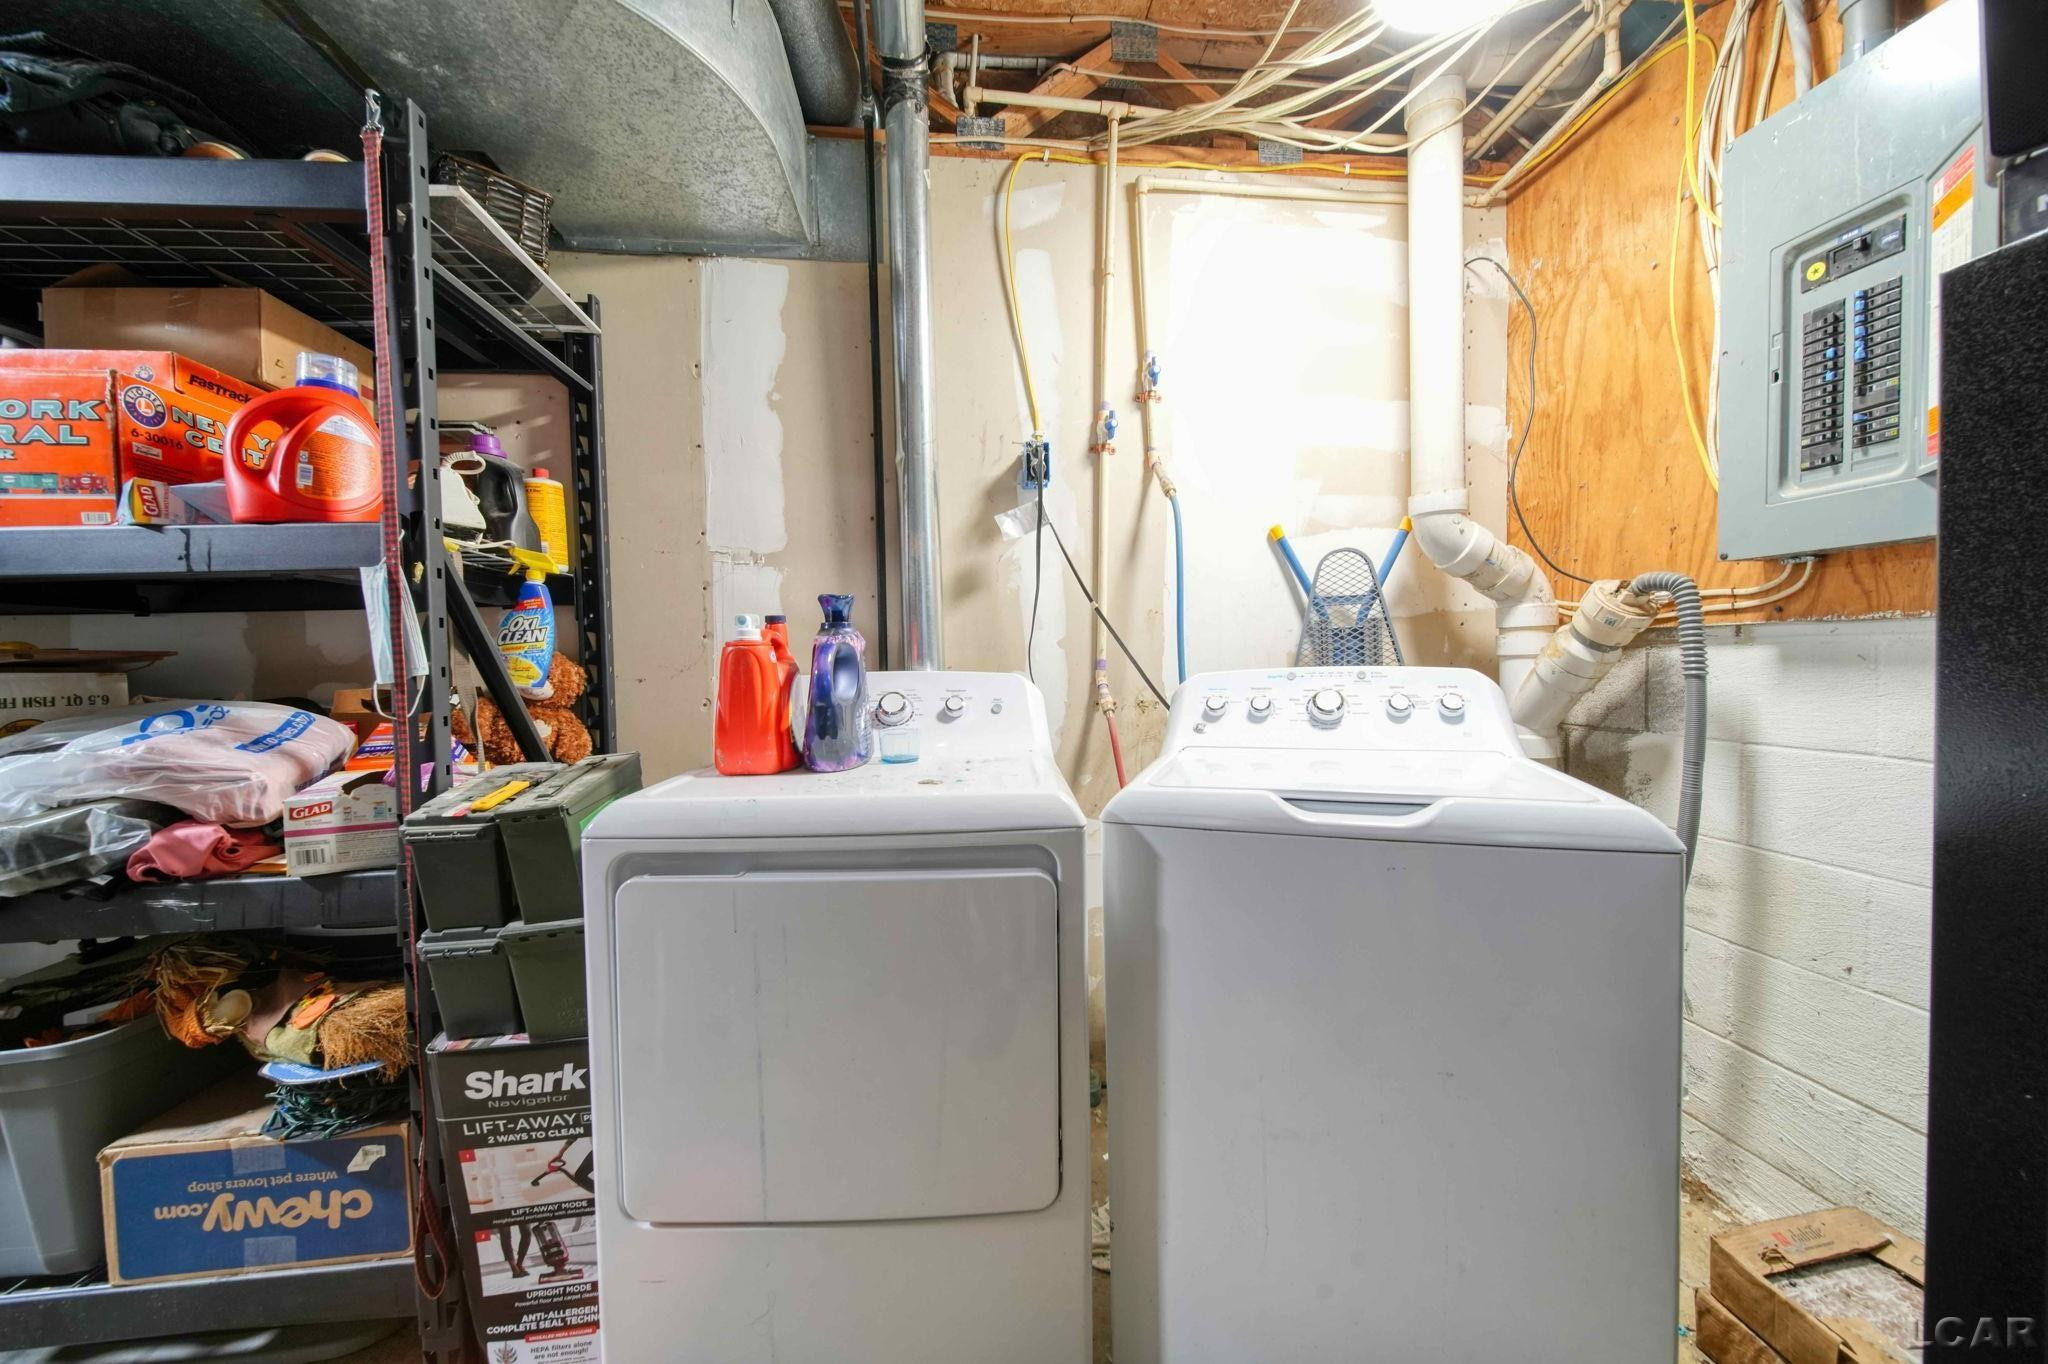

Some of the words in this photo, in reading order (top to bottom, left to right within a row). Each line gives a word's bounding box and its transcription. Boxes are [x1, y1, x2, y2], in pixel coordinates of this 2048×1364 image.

[131, 428, 184, 450] 6-30016
[140, 486, 159, 516] GLAD
[509, 616, 539, 632] OXI
[497, 628, 548, 646] CLEAN
[22, 696, 56, 708] FISH
[61, 693, 84, 707] QT.
[87, 694, 110, 706] 6.5
[292, 803, 331, 819] GLAD
[464, 1063, 588, 1100] Shark
[488, 1094, 569, 1109] Navigator
[463, 1113, 578, 1136] LIFT-AWAY
[487, 1136, 495, 1144] 2
[497, 1131, 528, 1143] WAYS
[530, 1131, 545, 1140] TO
[548, 1127, 585, 1138] CLEAN
[226, 1176, 267, 1188] lovers
[269, 1172, 292, 1188] pet
[295, 1170, 338, 1182] where
[187, 1180, 224, 1194] shop
[154, 1189, 373, 1232] chewy.com
[511, 1203, 559, 1216] LIFT-AWAY
[562, 1200, 588, 1209] MODE
[526, 1286, 564, 1299] UPRIGHT
[566, 1283, 592, 1293] MODE
[521, 1305, 598, 1323] ANTI-ALLERGEN
[486, 1321, 538, 1335] COMPLETE
[539, 1319, 565, 1329] SEAL
[530, 1344, 550, 1354] HEPA
[551, 1341, 571, 1352] filters
[573, 1339, 593, 1349] alone
[547, 1350, 559, 1358] not
